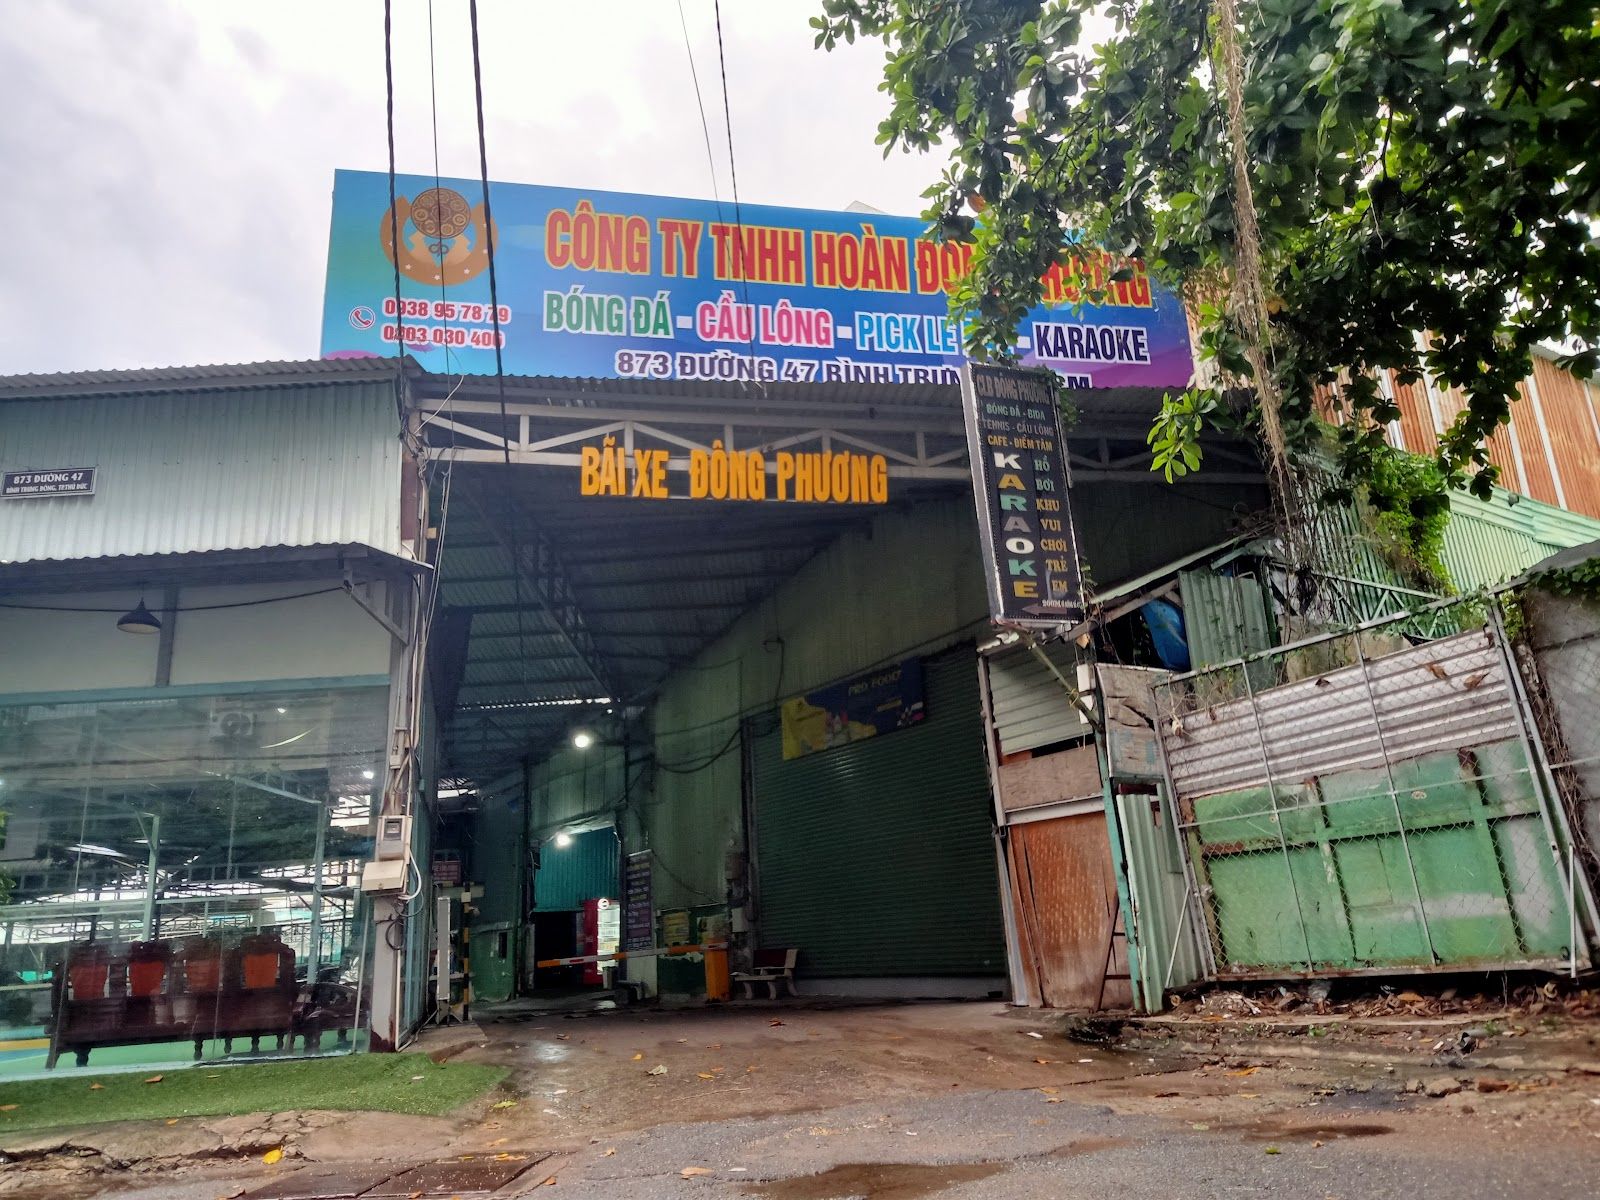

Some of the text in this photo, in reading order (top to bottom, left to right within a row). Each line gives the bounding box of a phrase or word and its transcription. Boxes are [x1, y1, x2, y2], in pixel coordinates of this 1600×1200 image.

[545, 200, 651, 275] CÔNG
[657, 218, 703, 279] TY
[709, 222, 806, 285] TNHH
[811, 223, 910, 294] HOÀN
[384, 298, 430, 317] 0938
[434, 302, 457, 319] 95
[460, 304, 483, 321] 78
[543, 285, 628, 333] BÓNG
[630, 289, 674, 339] ĐÁ
[696, 290, 757, 342] CẦU
[758, 298, 834, 349] LÔNG
[1033, 322, 1151, 365] KARAOKE
[433, 328, 466, 345] 030
[615, 350, 672, 379] 873
[677, 349, 774, 382] ĐƯỜNG
[783, 358, 819, 383] 47
[822, 356, 896, 384] BÌNH
[976, 374, 994, 397] CLB
[986, 402, 1009, 416] BÓNG
[1028, 408, 1046, 420] BIDA
[982, 419, 1010, 431] TENNIS
[1034, 423, 1054, 437] LÔNG
[987, 435, 1008, 447] CAFE
[581, 435, 888, 503] BÃI XE ĐÔNG PHƯƠNG
[13, 476, 32, 484] 873
[71, 472, 84, 481] 47
[1036, 478, 1055, 492] BƠI
[1036, 498, 1060, 512] KHU
[1040, 518, 1062, 532] VUI
[1040, 538, 1067, 552] CHƠI
[1045, 556, 1068, 572] TRẺ
[1052, 580, 1068, 592] EM
